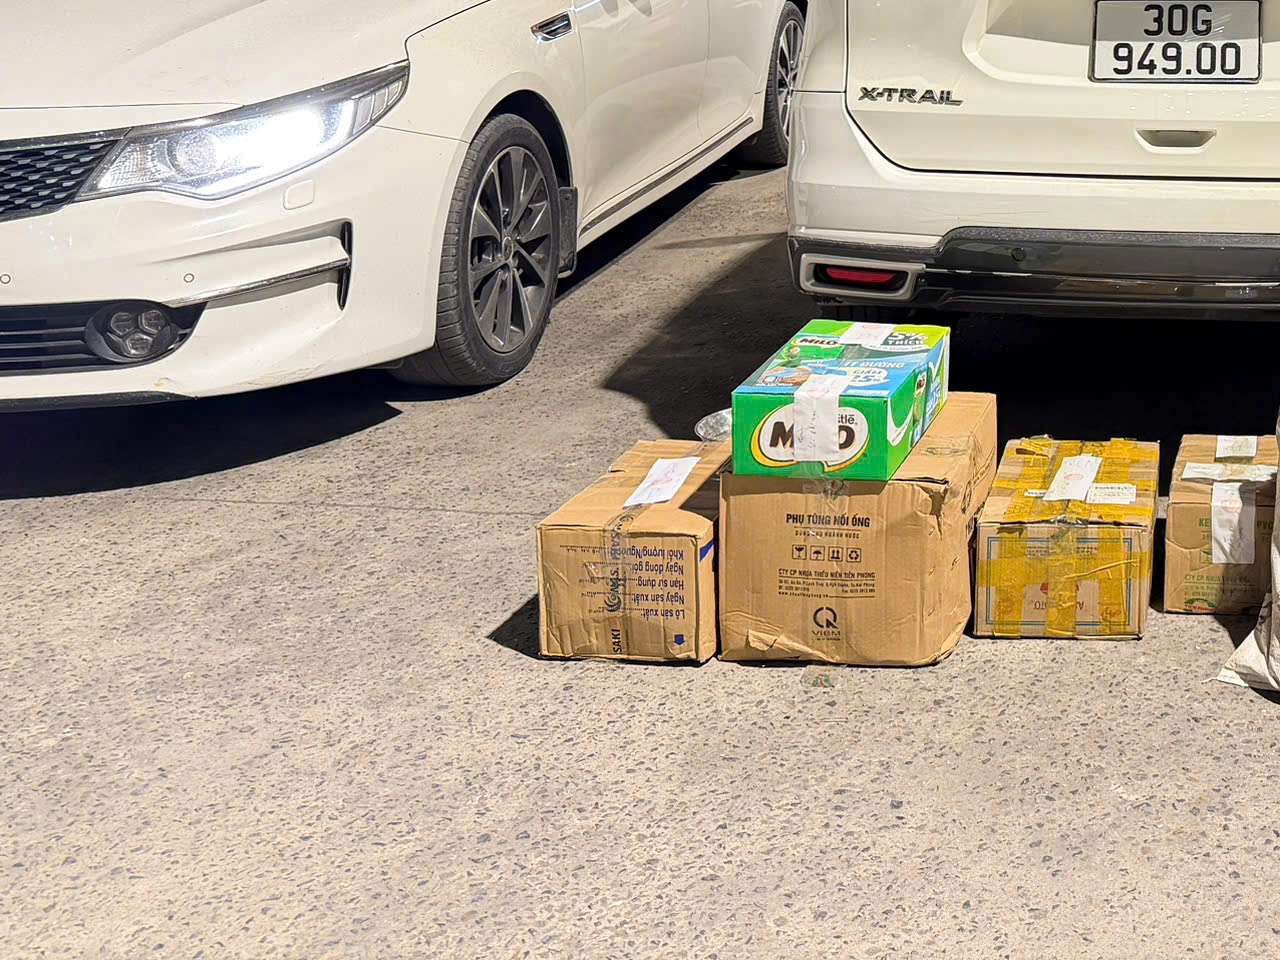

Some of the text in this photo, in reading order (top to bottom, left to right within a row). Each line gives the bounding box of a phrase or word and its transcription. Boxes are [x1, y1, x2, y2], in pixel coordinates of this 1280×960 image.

[1143, 4, 1213, 36] 30G
[1113, 42, 1241, 75] 949.00
[858, 86, 963, 106] X-TRAIL
[800, 337, 839, 346] MILO
[769, 421, 855, 450] MO
[1256, 520, 1274, 529] PVC
[666, 562, 684, 574] Ngày
[666, 592, 685, 605] Ngày
